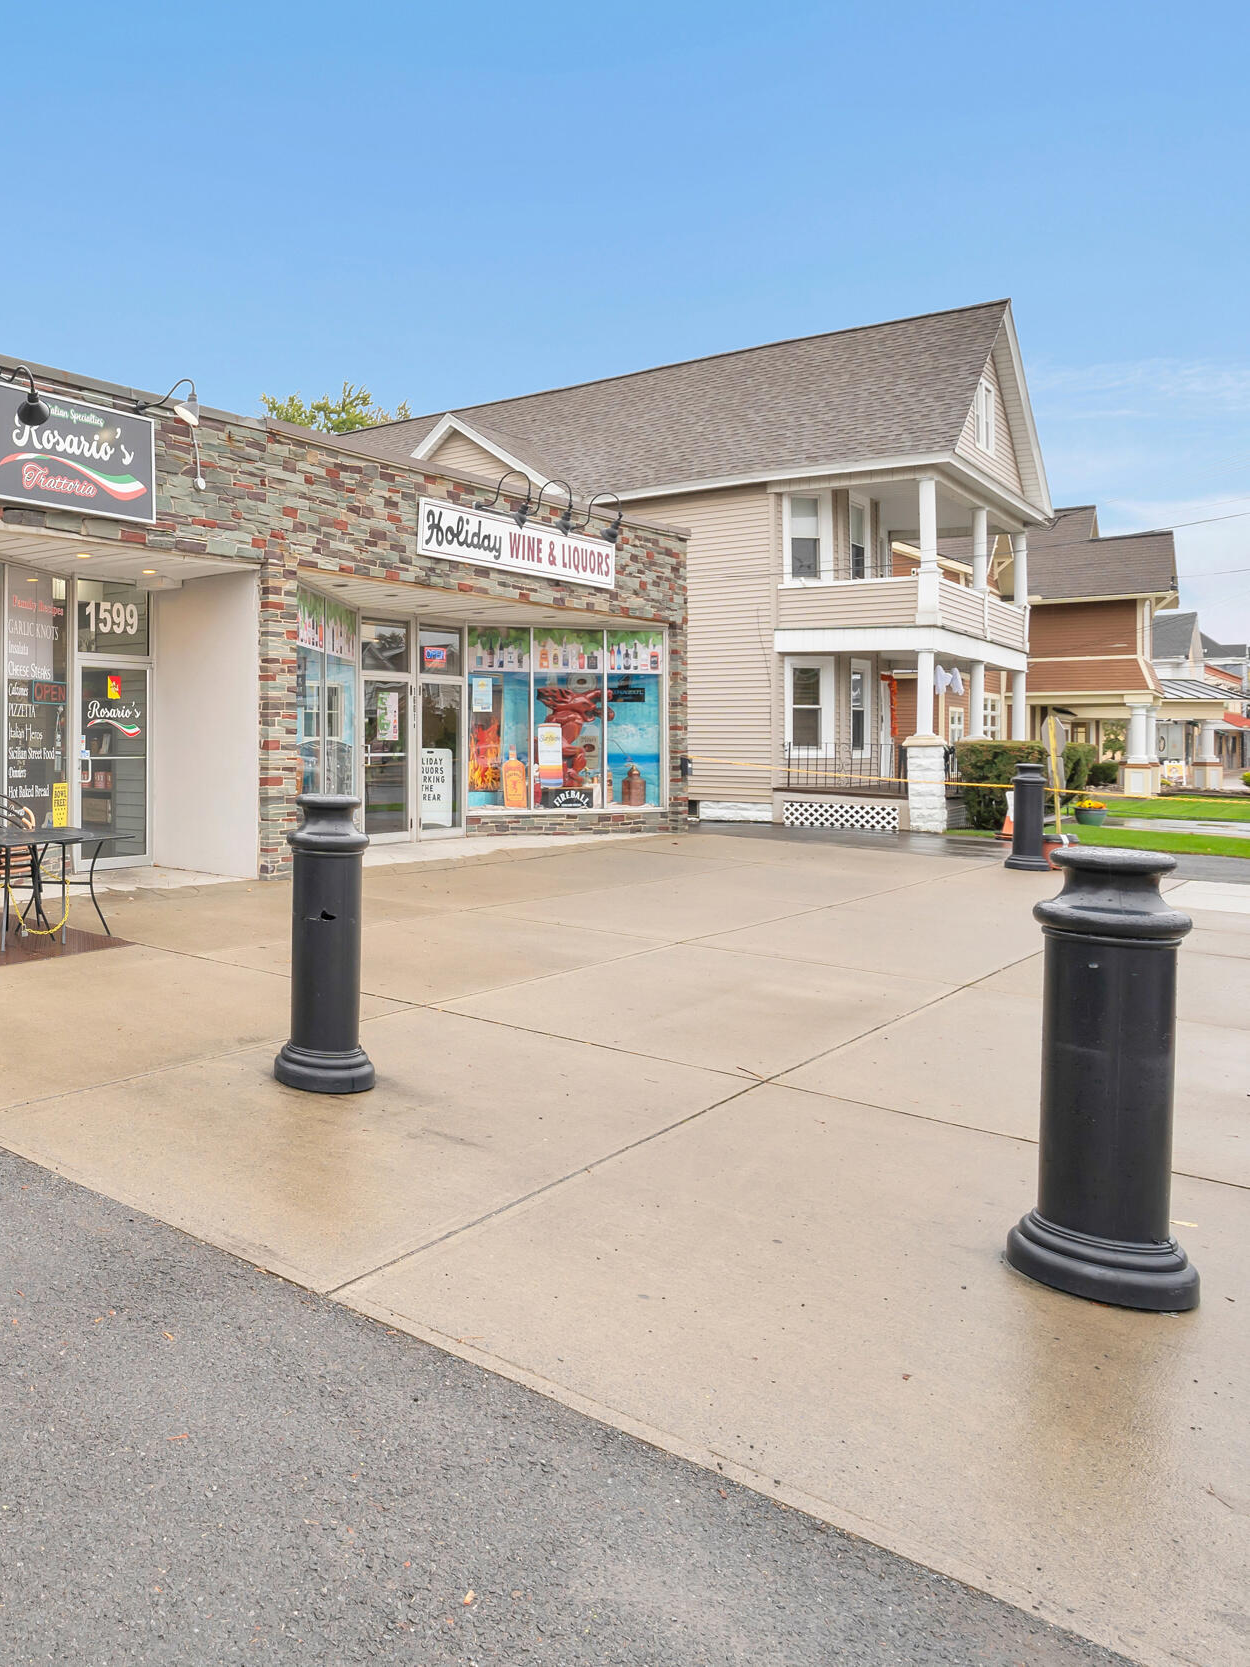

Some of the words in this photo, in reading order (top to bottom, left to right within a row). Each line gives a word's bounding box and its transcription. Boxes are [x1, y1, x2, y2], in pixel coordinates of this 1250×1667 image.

[12, 412, 134, 466] Rosario's
[22, 463, 97, 498] Trattoria
[425, 508, 502, 560] Holiday
[509, 531, 543, 564] WINE
[548, 540, 557, 567] &
[561, 544, 610, 578] LIQUORS
[85, 600, 139, 635] 1599
[8, 619, 34, 637] GARLIC
[36, 623, 59, 641] KNOTS
[34, 682, 66, 702] OPEN
[8, 703, 36, 718] PIZZETTA
[87, 700, 142, 719] Rosario's
[28, 747, 42, 760] Street
[42, 747, 55, 760] Food
[8, 785, 18, 798] Hot
[19, 784, 34, 797] Baked
[35, 784, 50, 797] Bread
[422, 793, 441, 801] REAR
[553, 789, 590, 807] FIREBALL
